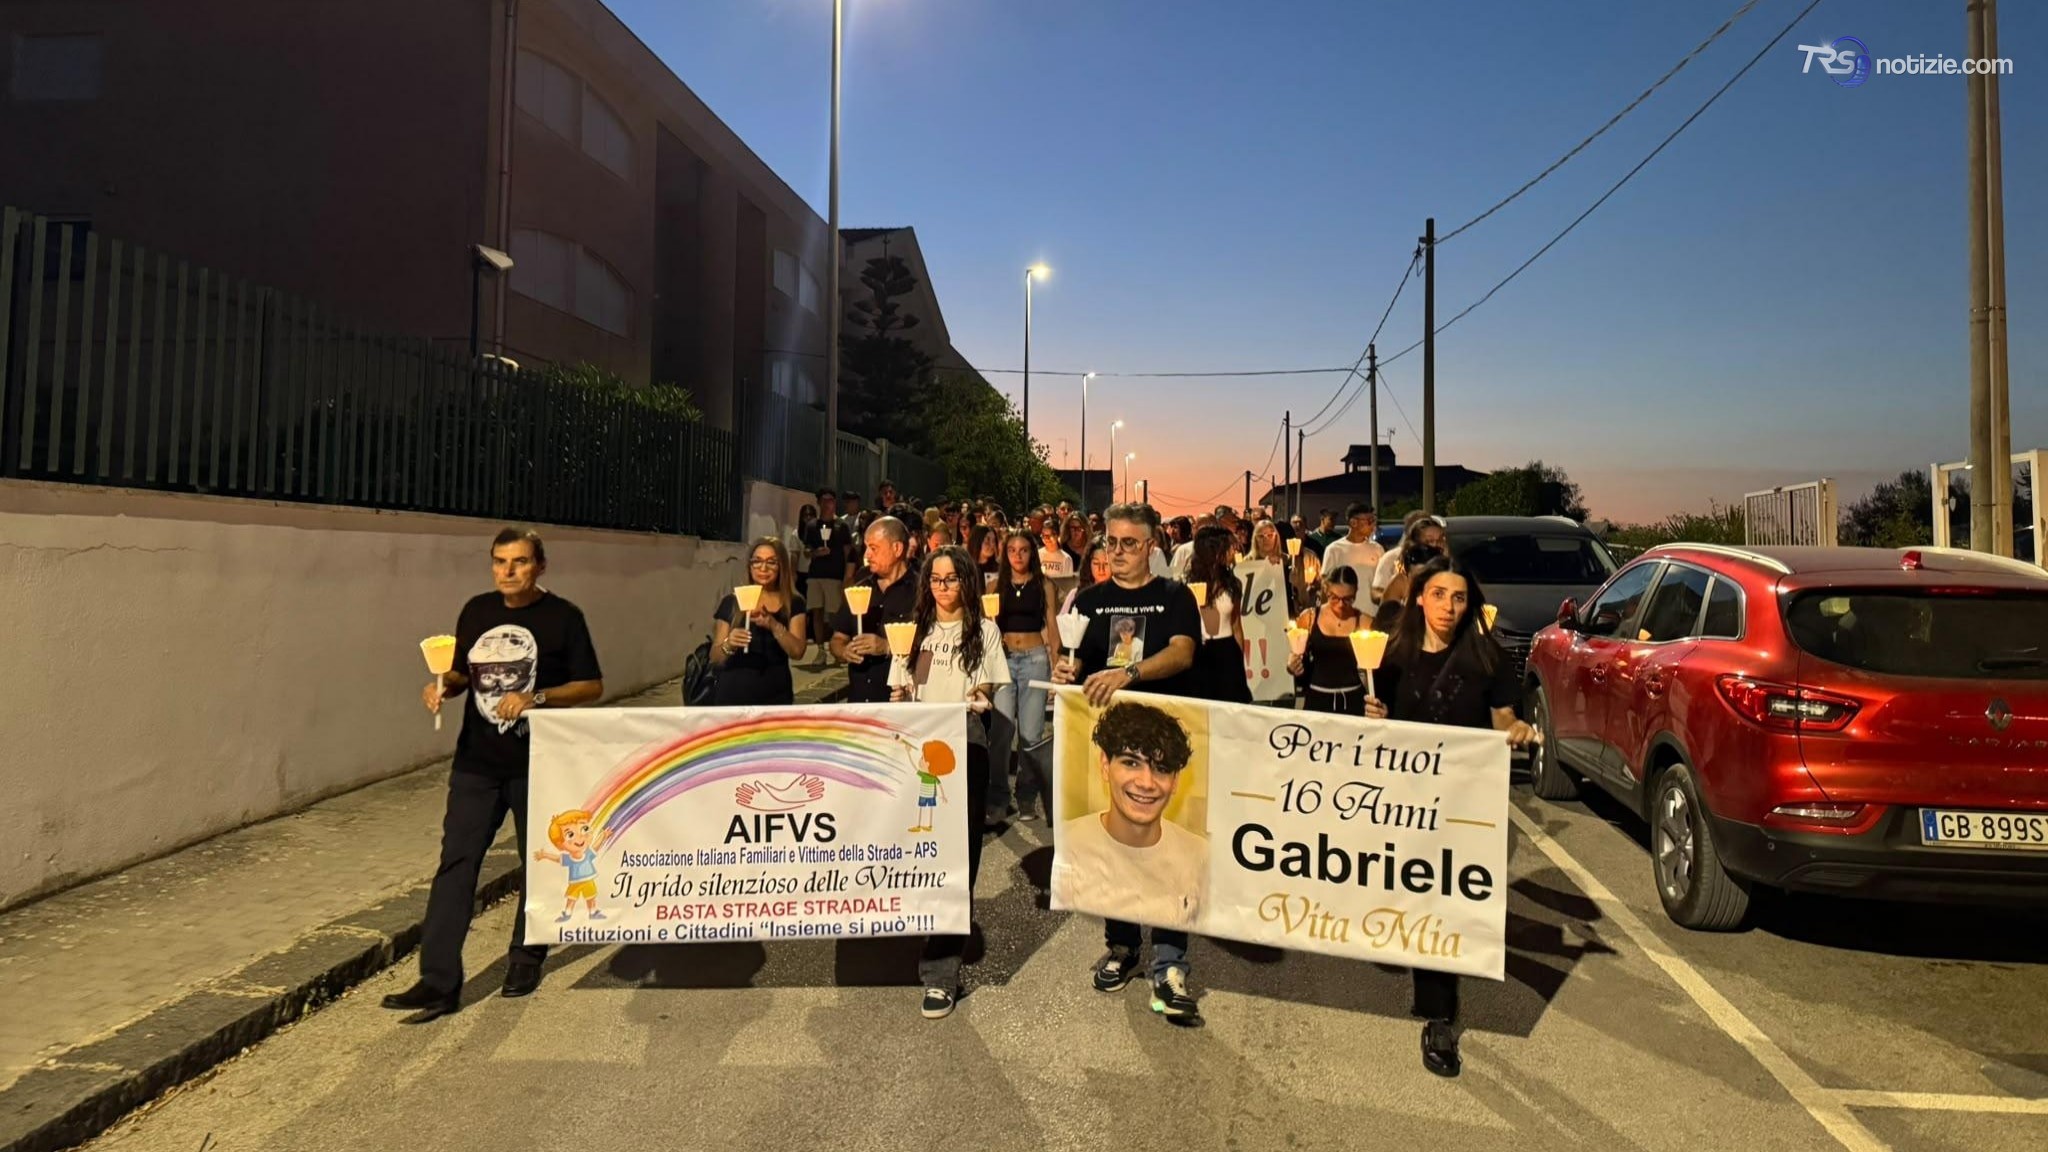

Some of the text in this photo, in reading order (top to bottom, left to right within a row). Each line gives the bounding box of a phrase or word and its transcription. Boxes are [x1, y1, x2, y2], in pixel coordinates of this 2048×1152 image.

[1104, 605, 1155, 614] GABRIELE VIVE
[1269, 722, 1444, 776] Per i tuoi
[1280, 778, 1440, 831] 16 Anni
[724, 812, 837, 844] AIFVS
[1980, 816, 2048, 842] 899S
[621, 850, 693, 867] Associazione
[697, 848, 736, 866] Italiana
[740, 845, 786, 864] Familiari
[789, 851, 795, 863] e
[798, 845, 836, 863] Vittime
[839, 844, 864, 861] della
[867, 843, 903, 861] Strada
[914, 841, 938, 858] APS
[1231, 823, 1494, 902] Gabriele
[610, 865, 947, 908] Il grido silenzioso delle Vittime
[656, 897, 901, 920] BASTA STRAGE STRADALE
[559, 925, 651, 942] Istituzioni
[658, 928, 668, 940] e
[675, 922, 753, 940] Cittadini
[848, 918, 864, 934] si
[1258, 892, 1462, 958] Vita Mia
